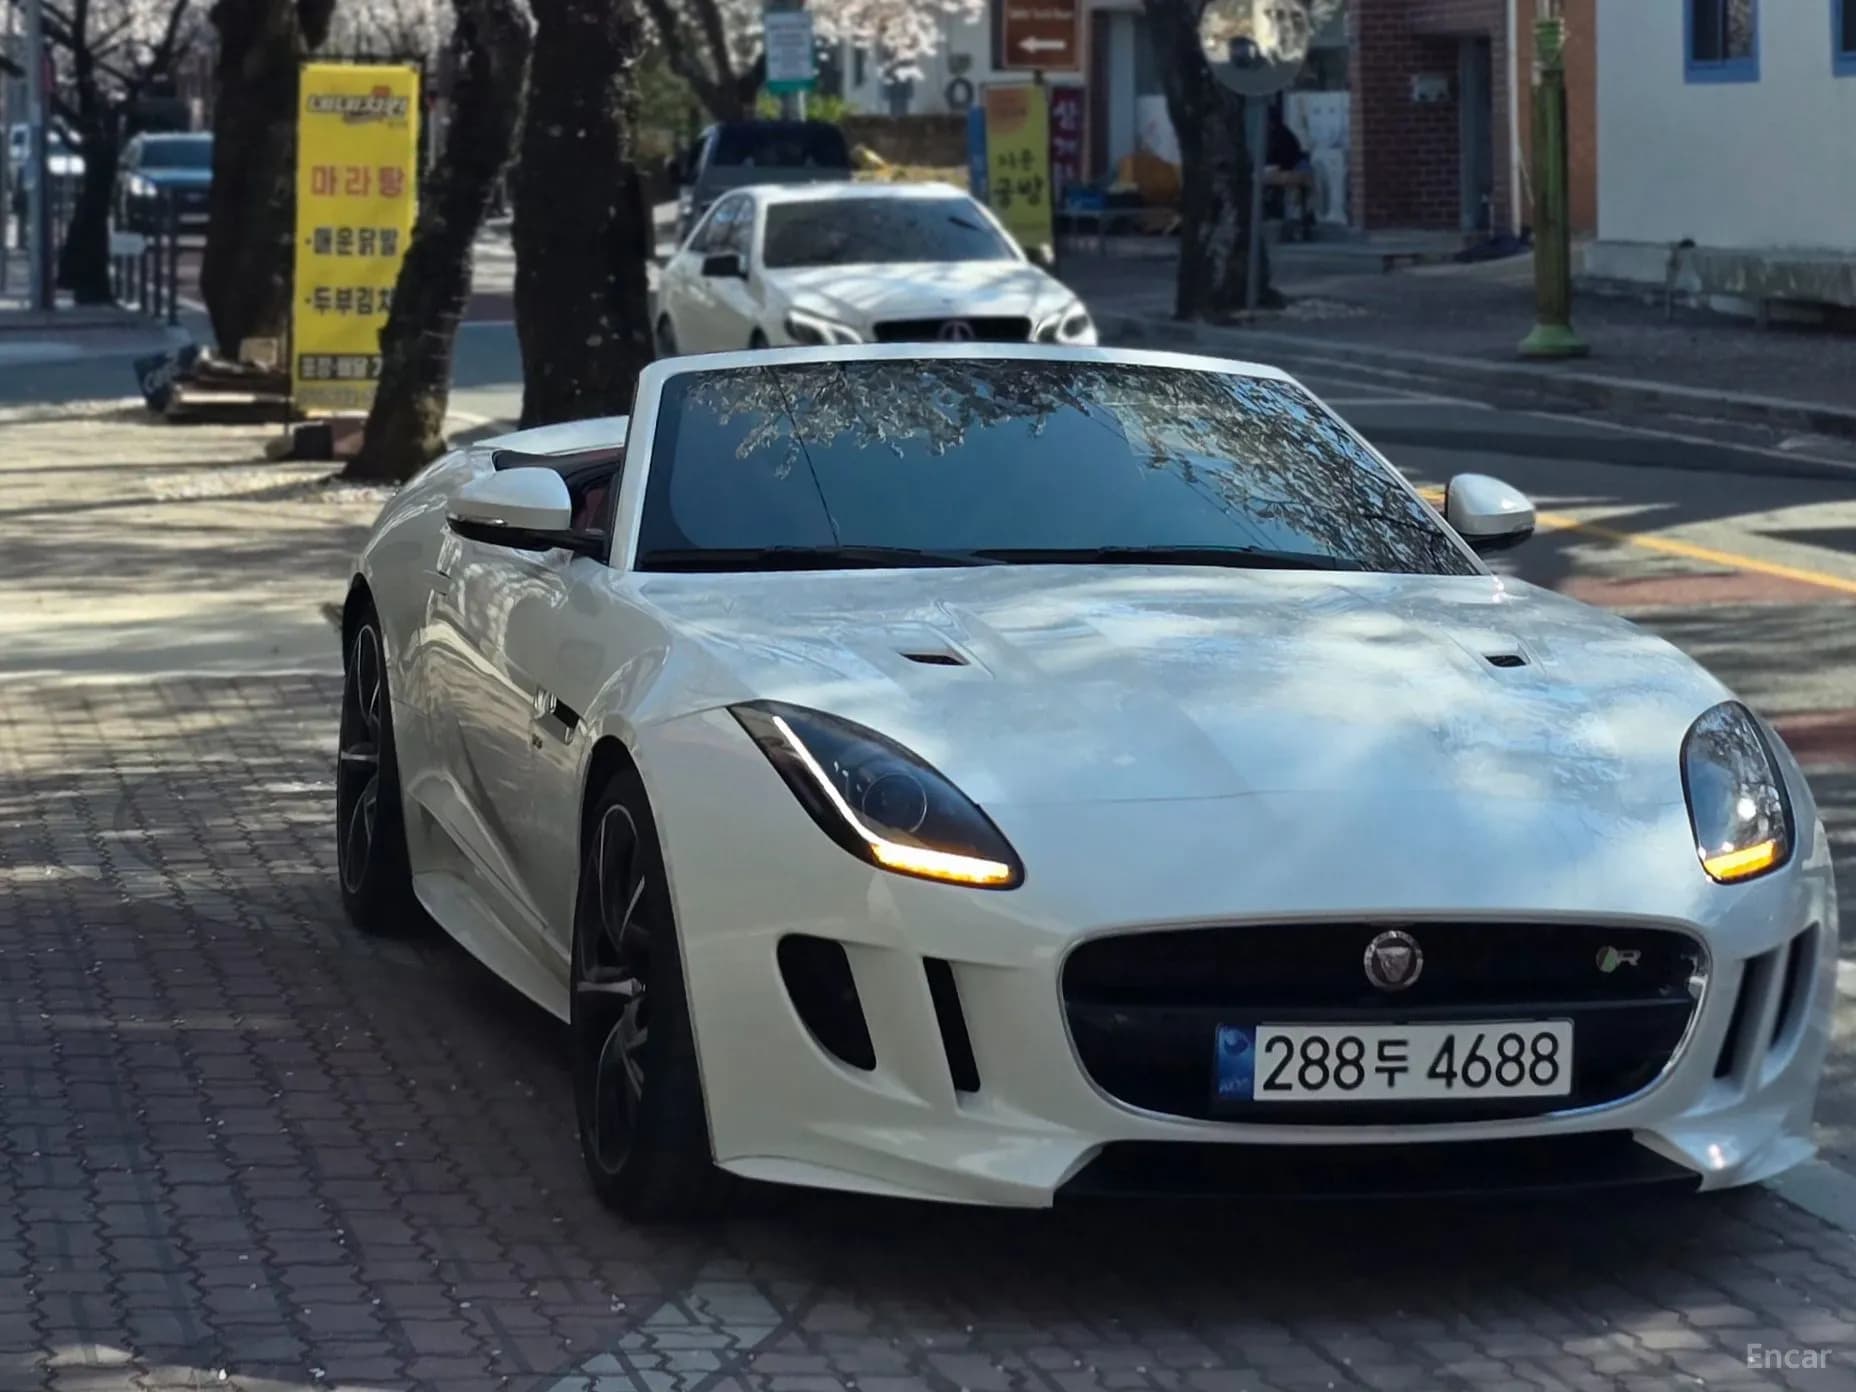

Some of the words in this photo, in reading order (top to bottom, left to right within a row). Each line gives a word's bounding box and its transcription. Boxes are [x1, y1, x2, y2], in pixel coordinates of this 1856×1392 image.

[311, 165, 405, 198] 마라탕
[1262, 1035, 1410, 1092] 288두
[1426, 1031, 1560, 1089] 4688
